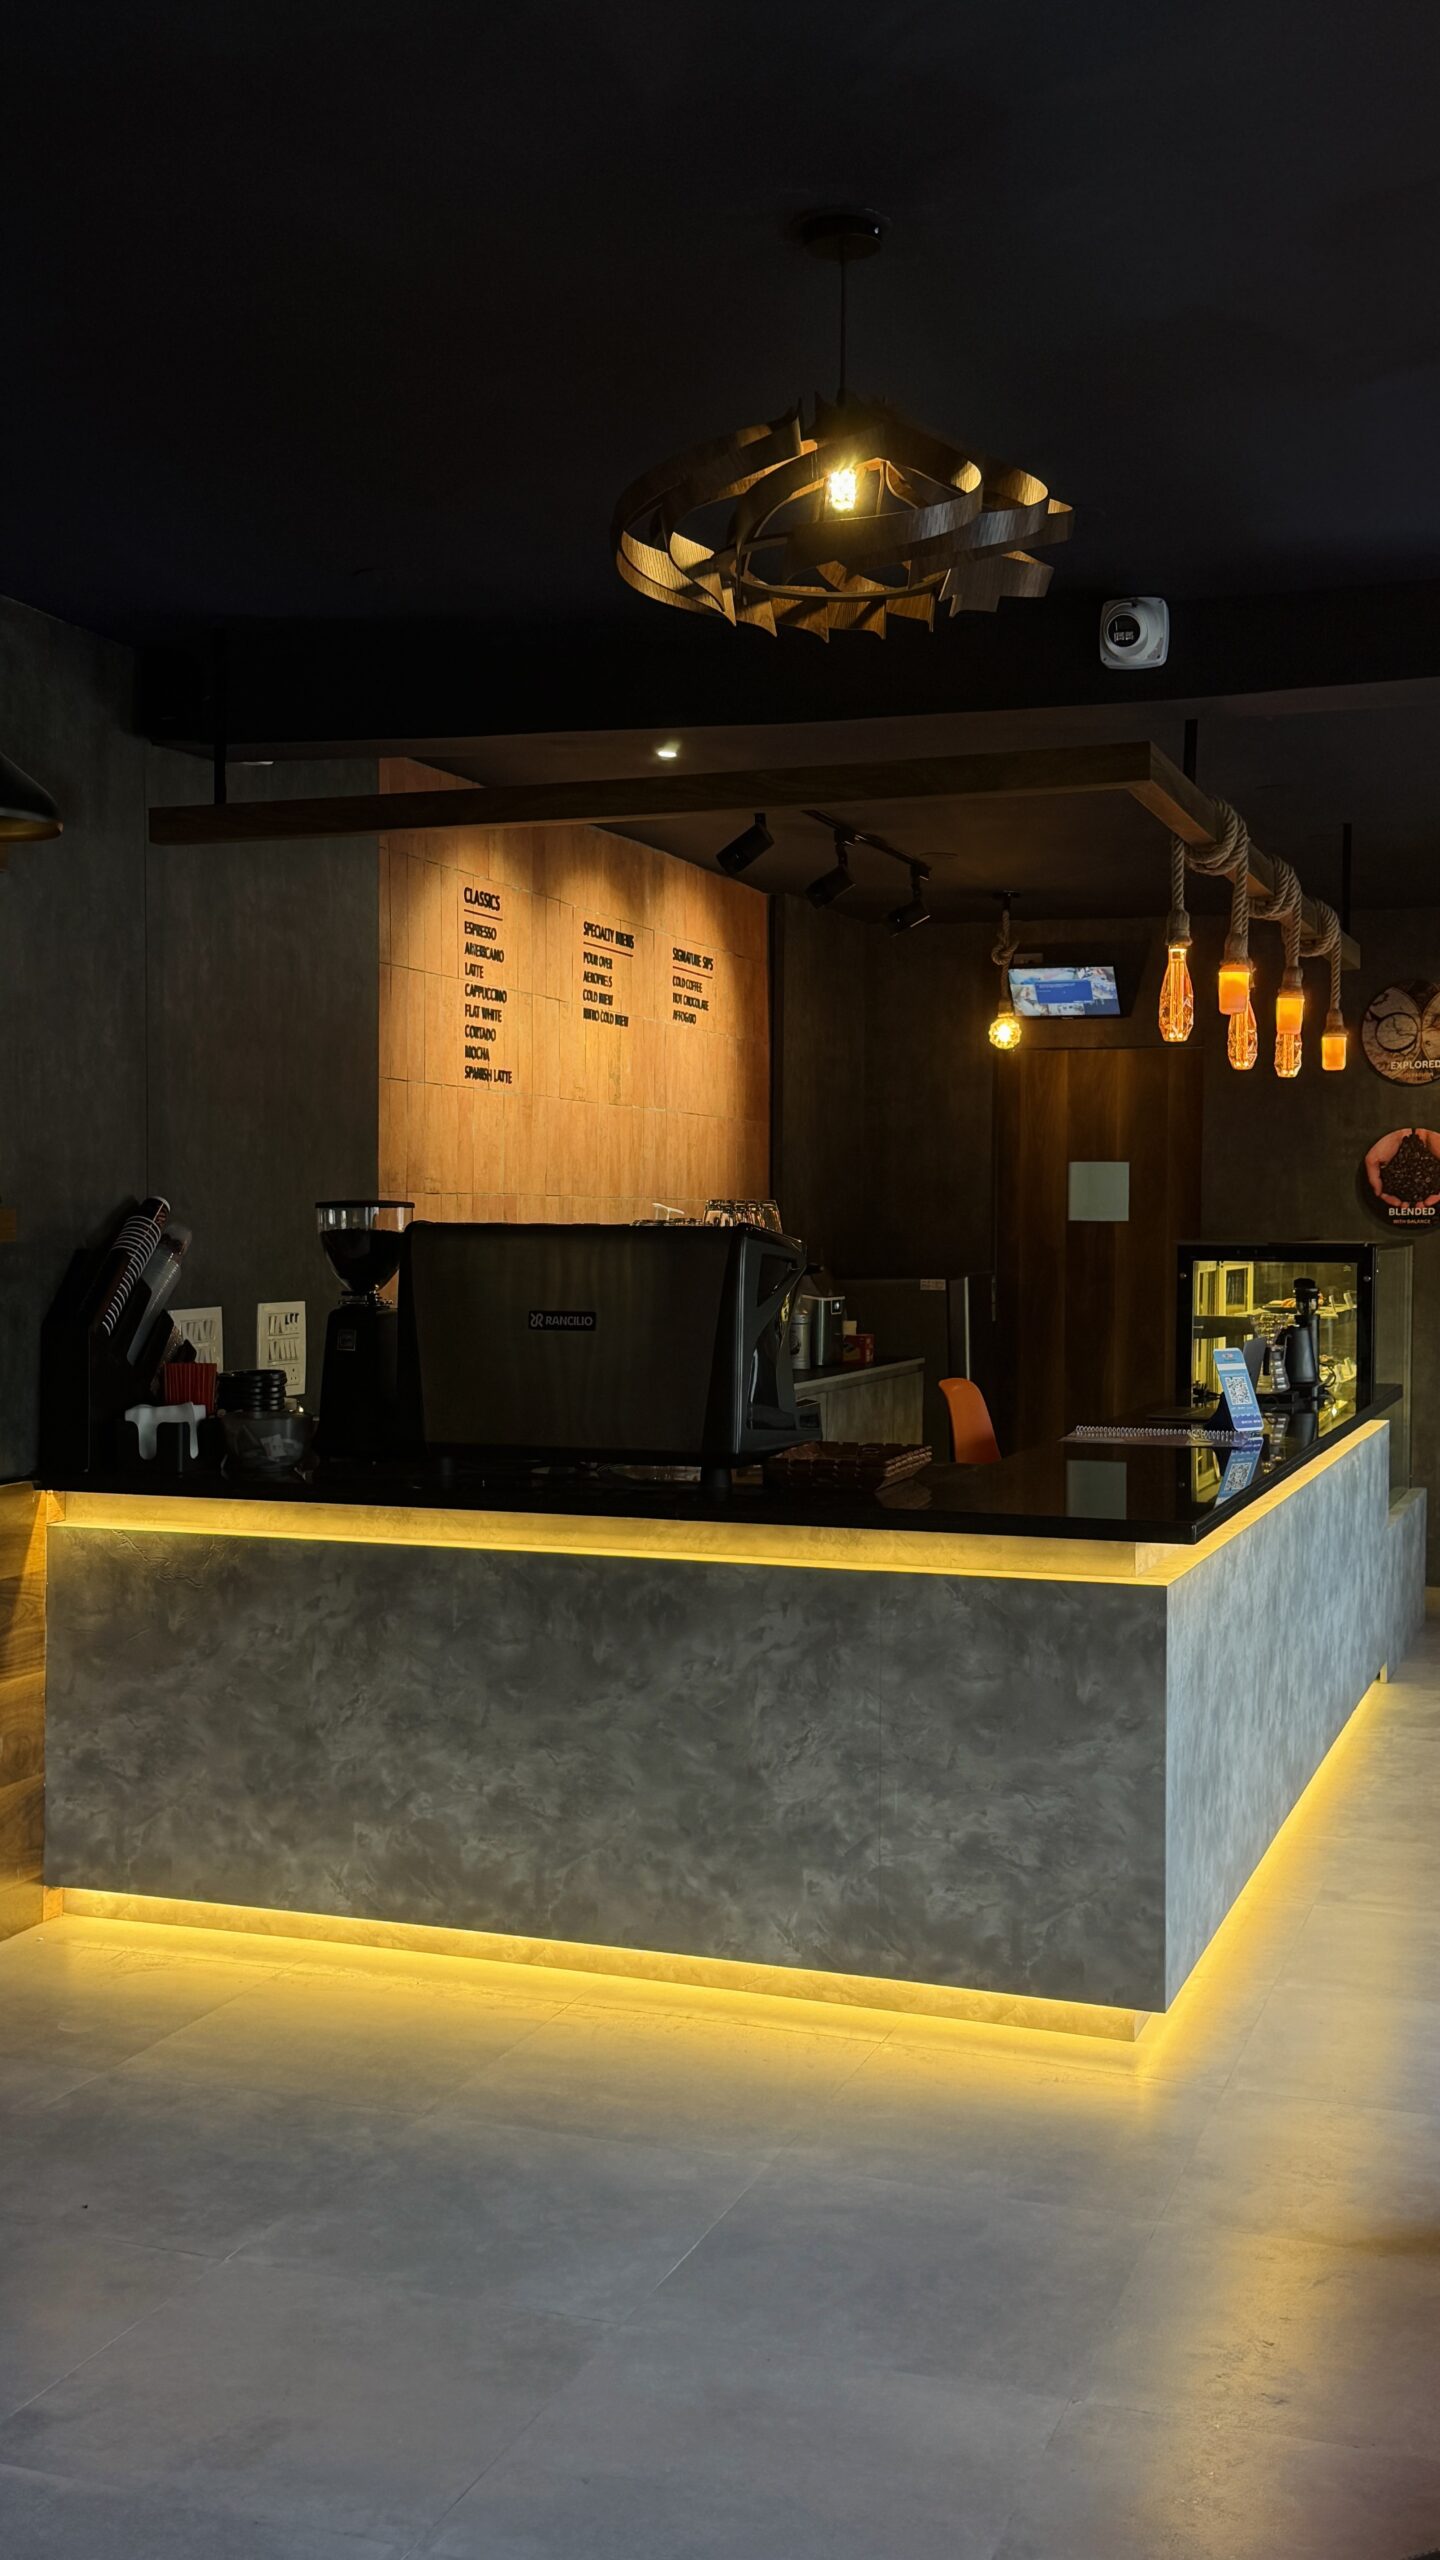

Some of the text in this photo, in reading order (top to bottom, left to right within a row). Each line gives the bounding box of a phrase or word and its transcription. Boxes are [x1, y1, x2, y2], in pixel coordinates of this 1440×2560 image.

[464, 887, 500, 911] CLASSICS
[464, 921, 497, 940] ESPRESSO
[583, 921, 634, 949] SPECIALTY BREWS
[464, 942, 504, 963] AMERICANO
[584, 952, 613, 970] POUR OVER
[673, 948, 714, 971] SIGNATURE SIPS
[465, 962, 484, 979] LATTE
[465, 983, 507, 1003] CAPPUCCINO
[673, 976, 703, 993] COLD COFFEE
[583, 989, 613, 1006] COLD BREW
[673, 992, 709, 1011] HOT CHOCOLATE
[465, 1004, 502, 1023] FLAT WHITE
[600, 1010, 614, 1025] COLD
[615, 1014, 629, 1027] BREW
[673, 1010, 697, 1024] AFFOGATO
[465, 1025, 496, 1042] CORTADO
[465, 1045, 490, 1061] MOCHA
[1390, 1060, 1440, 1070] EXPLORED
[465, 1066, 512, 1084] SPANISH LATTE
[1388, 1207, 1436, 1216] BLENDED
[545, 1315, 593, 1326] RANCILIO
